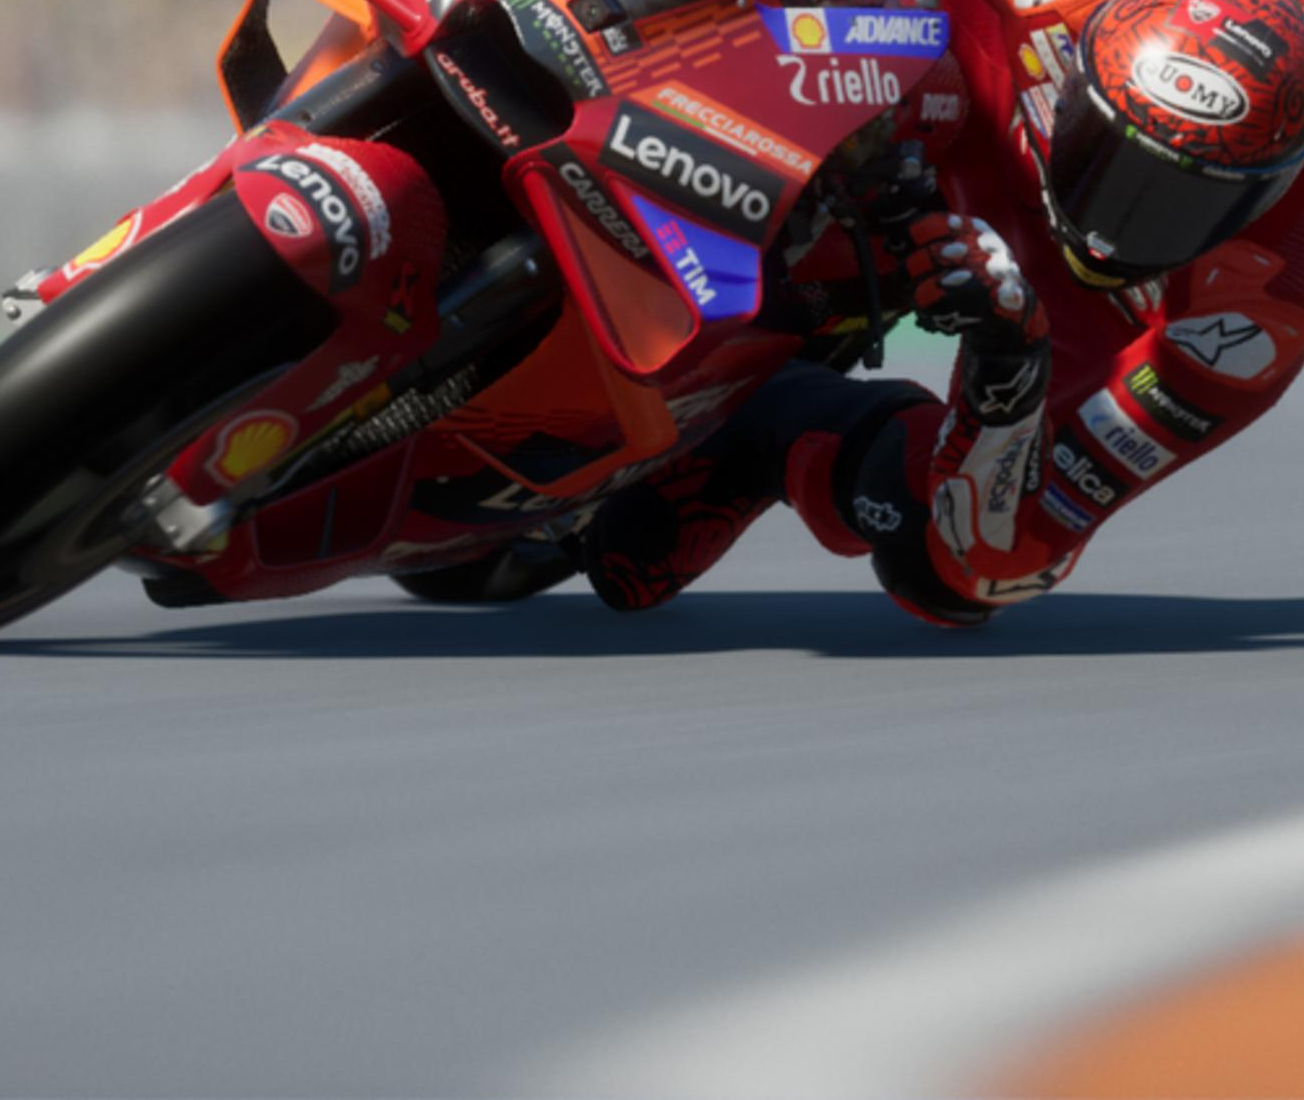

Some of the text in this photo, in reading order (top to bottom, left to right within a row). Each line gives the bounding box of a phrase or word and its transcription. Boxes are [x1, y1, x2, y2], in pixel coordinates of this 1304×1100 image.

[531, 0, 604, 98] MONSTER
[844, 15, 943, 46] ADVANCE
[437, 52, 521, 148] aruba.it
[816, 56, 901, 106] riello
[610, 114, 770, 222] Lenovo
[656, 87, 815, 176] FRECCIAROSSA
[255, 153, 360, 276] Lenovo
[559, 161, 649, 260] CARRERA
[676, 247, 717, 306] TIM
[1053, 443, 1116, 506] elica
[1105, 426, 1160, 471] riello
